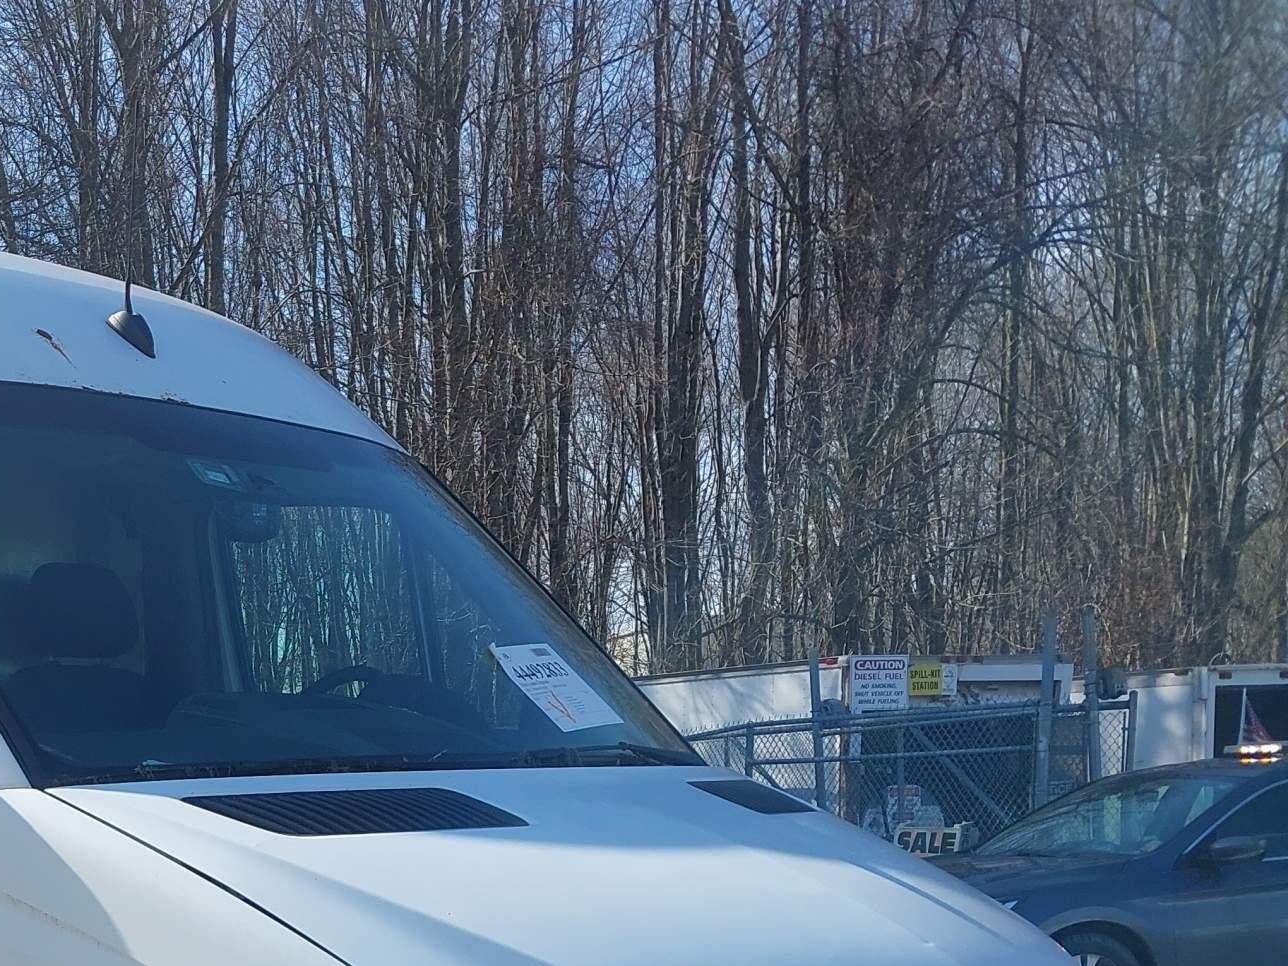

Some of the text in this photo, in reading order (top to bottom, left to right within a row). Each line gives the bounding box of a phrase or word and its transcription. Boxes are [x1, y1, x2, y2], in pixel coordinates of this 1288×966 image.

[856, 660, 904, 670] CAUTION
[854, 672, 904, 681] DIESEL FUEL
[910, 669, 941, 680] SPILL-KIT
[912, 681, 939, 691] STATION
[896, 830, 956, 854] SALE
